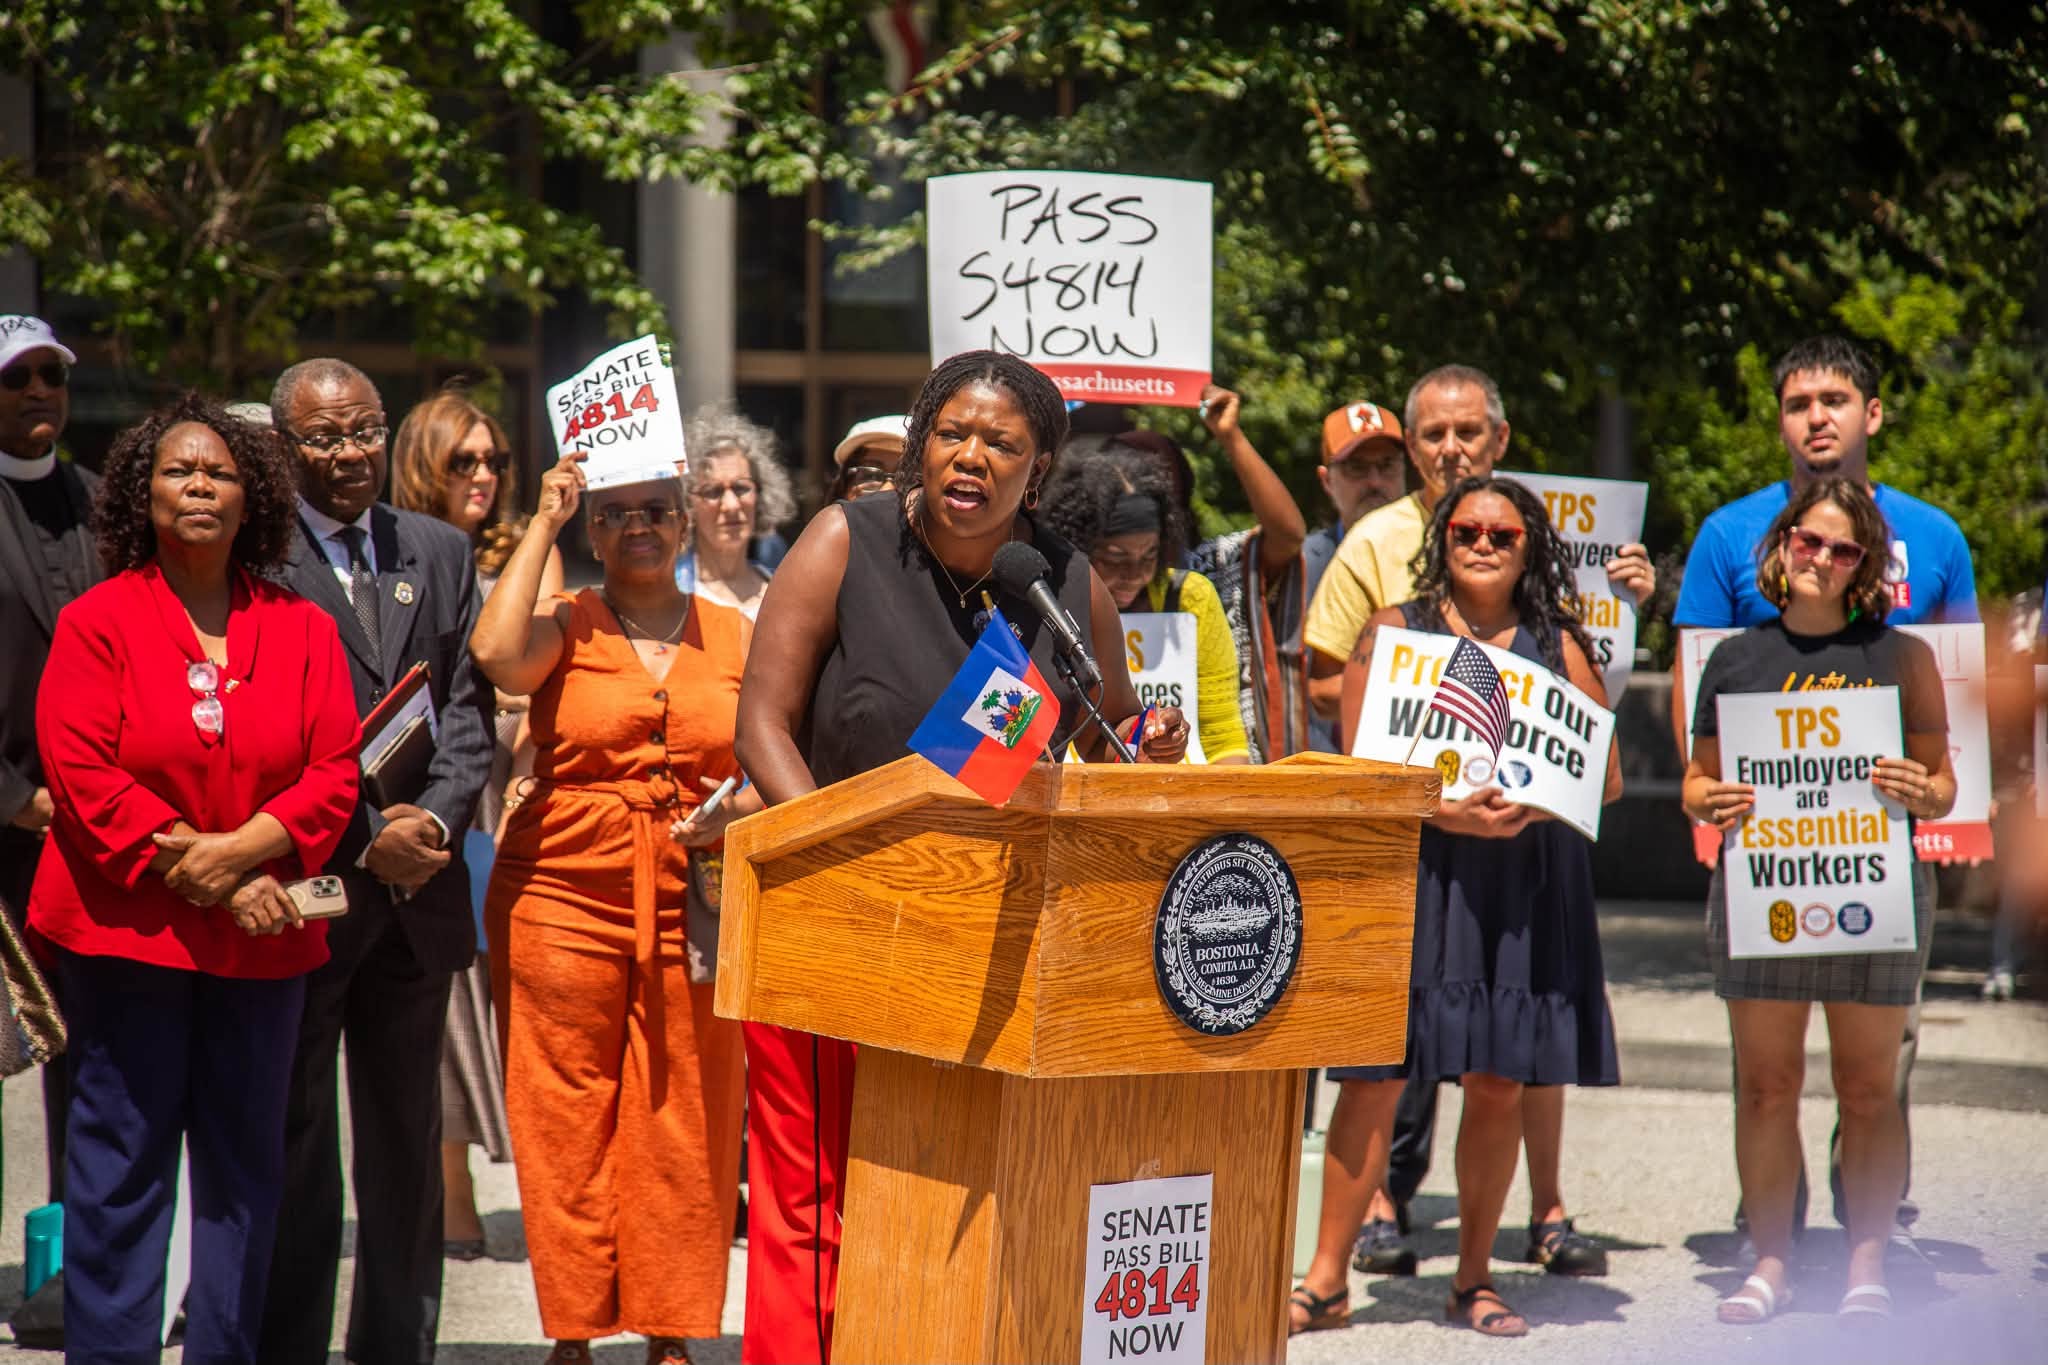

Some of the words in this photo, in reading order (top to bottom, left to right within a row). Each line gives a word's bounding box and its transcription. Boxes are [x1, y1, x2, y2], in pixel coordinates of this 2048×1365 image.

[991, 184, 1158, 245] PASS
[959, 250, 1144, 320] S4814
[990, 317, 1158, 358] NOW
[558, 349, 653, 414] SENATE
[611, 370, 656, 393] BILL
[1052, 370, 1176, 397] sachusetts
[563, 383, 660, 445] 4814
[576, 419, 648, 452] NOW
[1543, 489, 1597, 534] TPS
[1389, 643, 1535, 707] Proct
[1544, 685, 1598, 743] Our
[1775, 706, 1841, 750] TPS
[1796, 788, 1829, 809] are
[1742, 806, 1889, 849] Essential
[1193, 858, 1232, 893] PATRIBUS
[1232, 858, 1246, 869] SIT
[1246, 861, 1267, 883] DEUS
[1748, 851, 1887, 888] Workers
[1181, 933, 1199, 981] CIVITATIS
[1195, 977, 1233, 999] REGIMINE
[1233, 970, 1262, 997] DONATA
[1200, 959, 1238, 975] CONDITA
[1239, 958, 1256, 971] A.D.
[1101, 1202, 1208, 1242] SENATE
[1103, 1244, 1151, 1271] PASS
[1159, 1240, 1203, 1264] BILL
[1094, 1263, 1201, 1322] 4814
[1108, 1321, 1184, 1360] NOW
